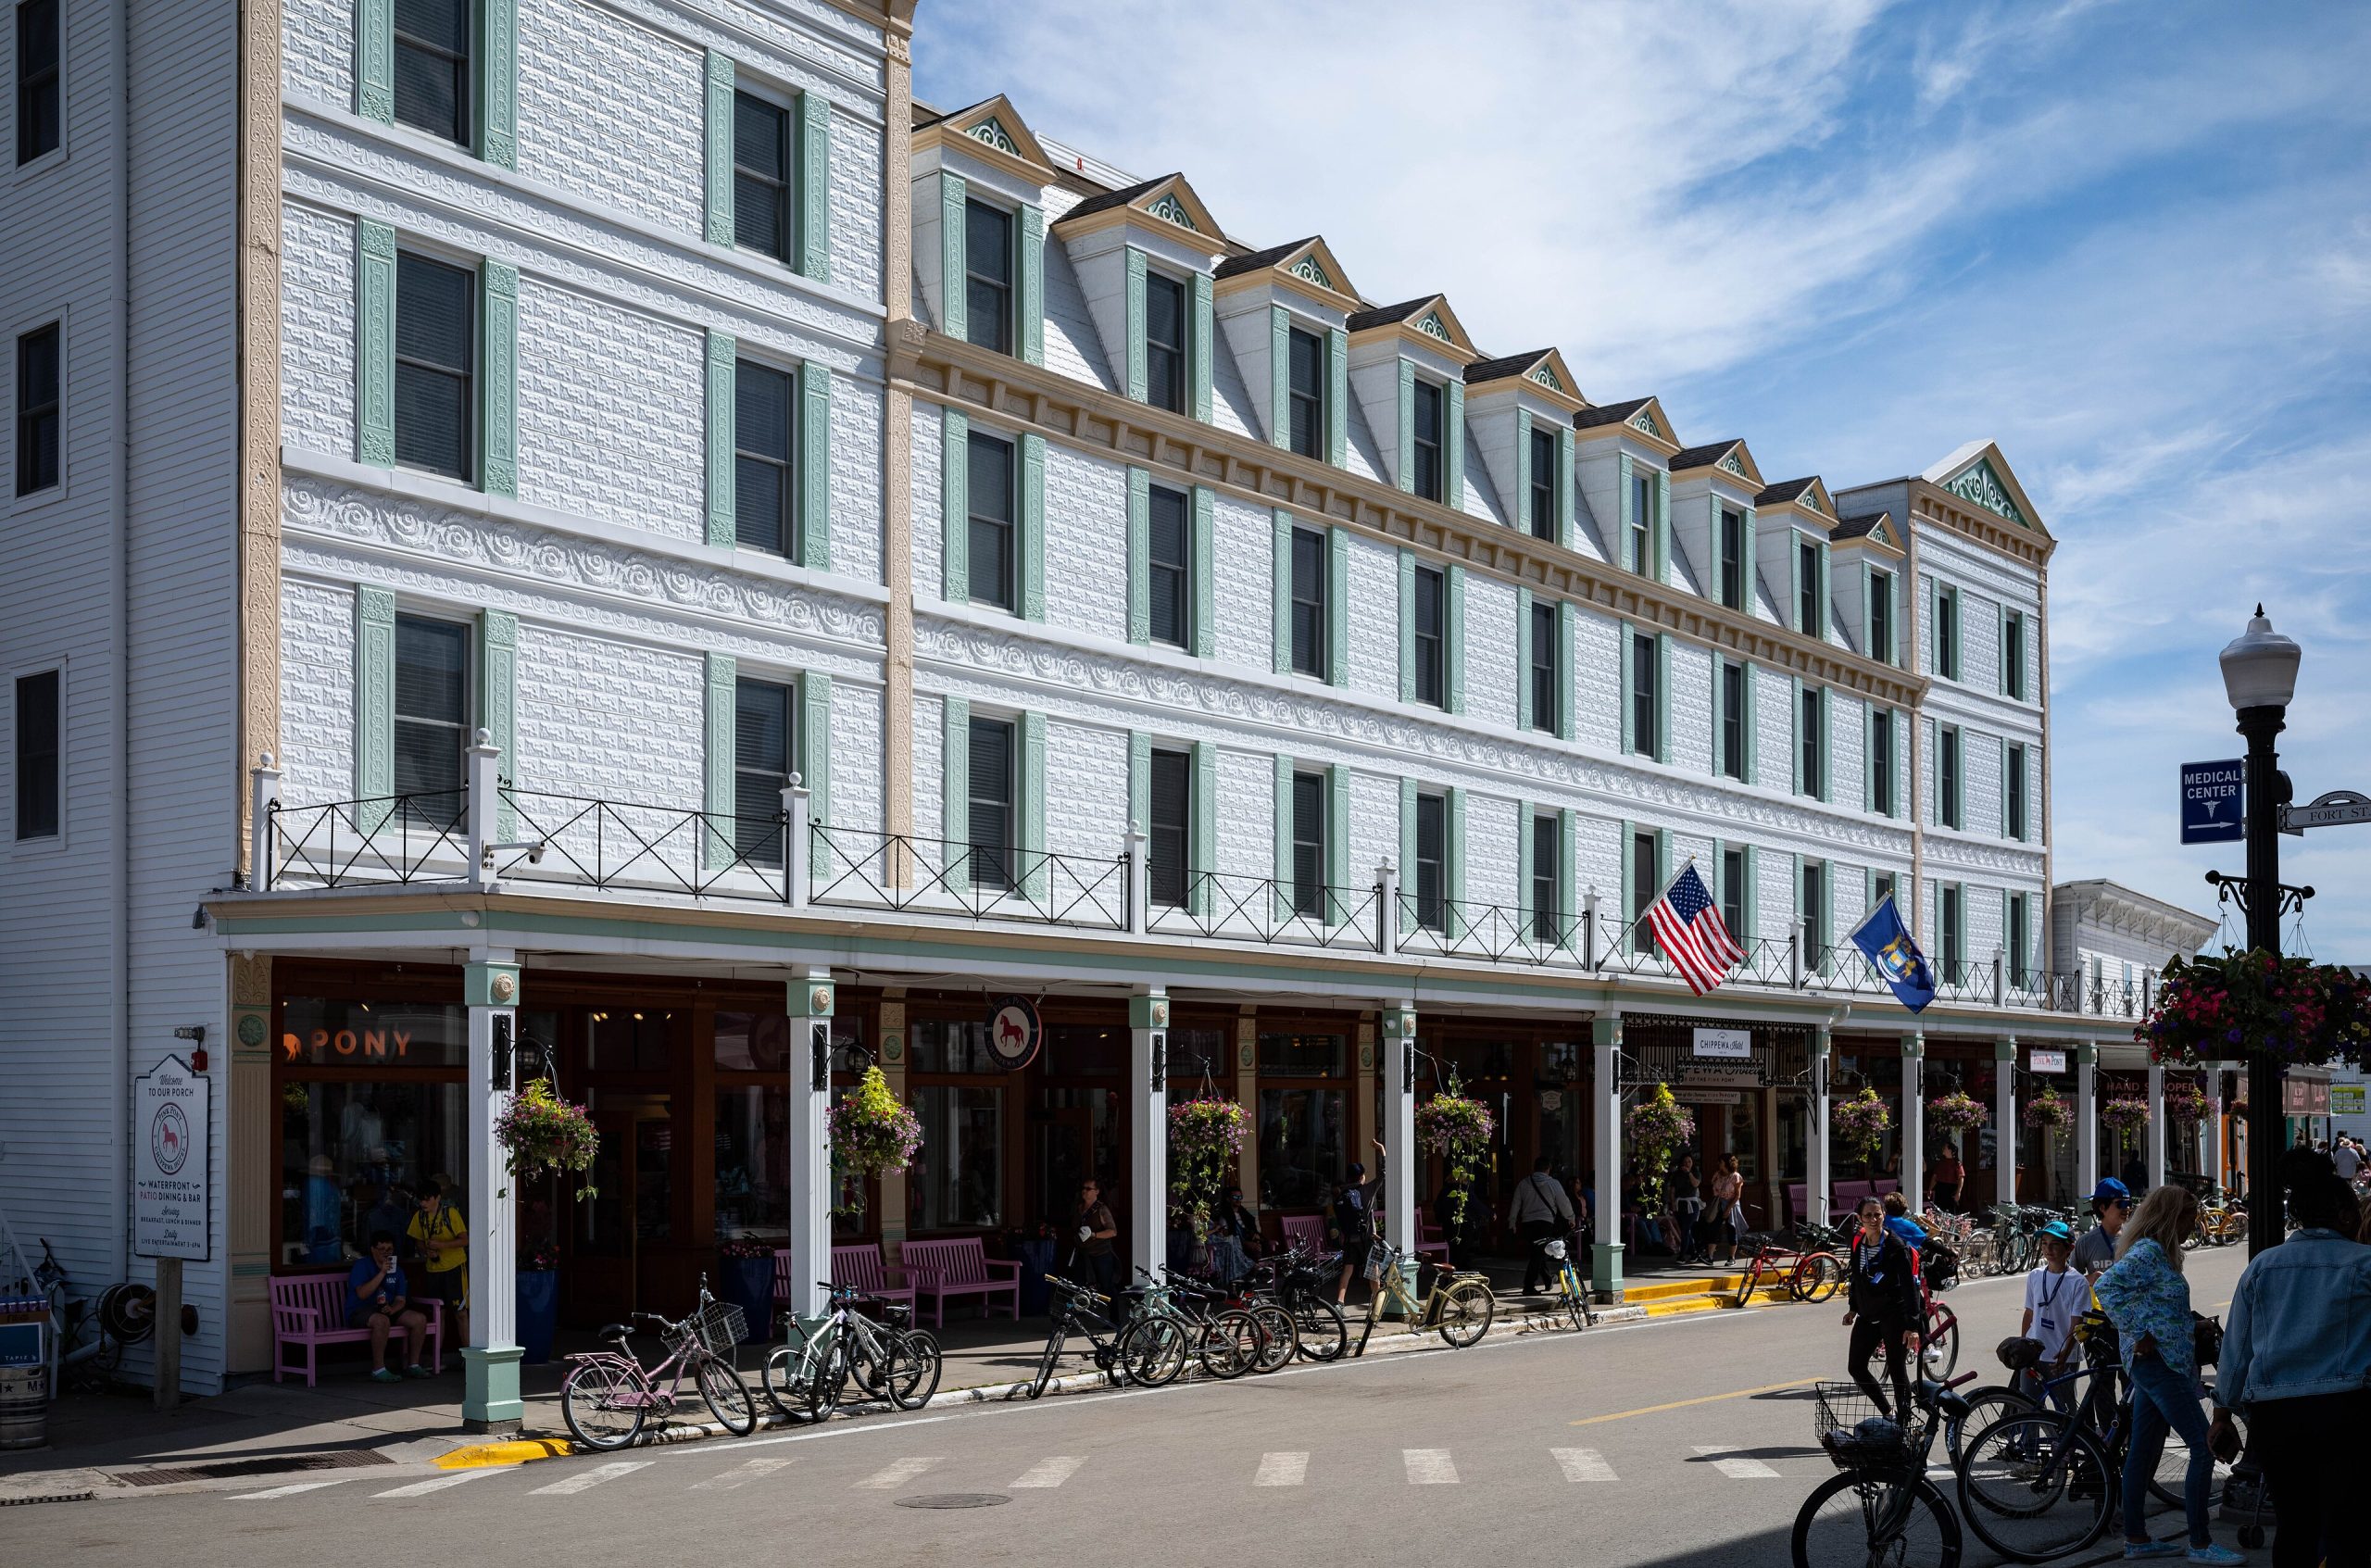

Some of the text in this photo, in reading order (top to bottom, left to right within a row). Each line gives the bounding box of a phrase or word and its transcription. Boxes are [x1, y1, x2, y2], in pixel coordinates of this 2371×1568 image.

[2184, 770, 2239, 785] MEDICAL
[2187, 784, 2237, 799] CENTER
[2315, 794, 2341, 805] Mackinac
[2311, 807, 2371, 822] FORT ST.
[310, 1028, 412, 1057] PONY
[1700, 1039, 1730, 1049] CHIPPEWA
[2033, 1054, 2064, 1066] PINK PONY
[159, 1073, 183, 1086] Welcome
[148, 1087, 194, 1098] TO OUR PORCH
[2105, 1081, 2140, 1092] HAND
[157, 1106, 182, 1122] PINK PONY
[148, 1180, 190, 1190] WATERFRONT
[141, 1191, 201, 1203] PATIO DINING & BAR
[161, 1206, 180, 1218] Serving
[164, 1229, 178, 1241] Daily
[150, 1238, 186, 1248] ENTERTAINMENT
